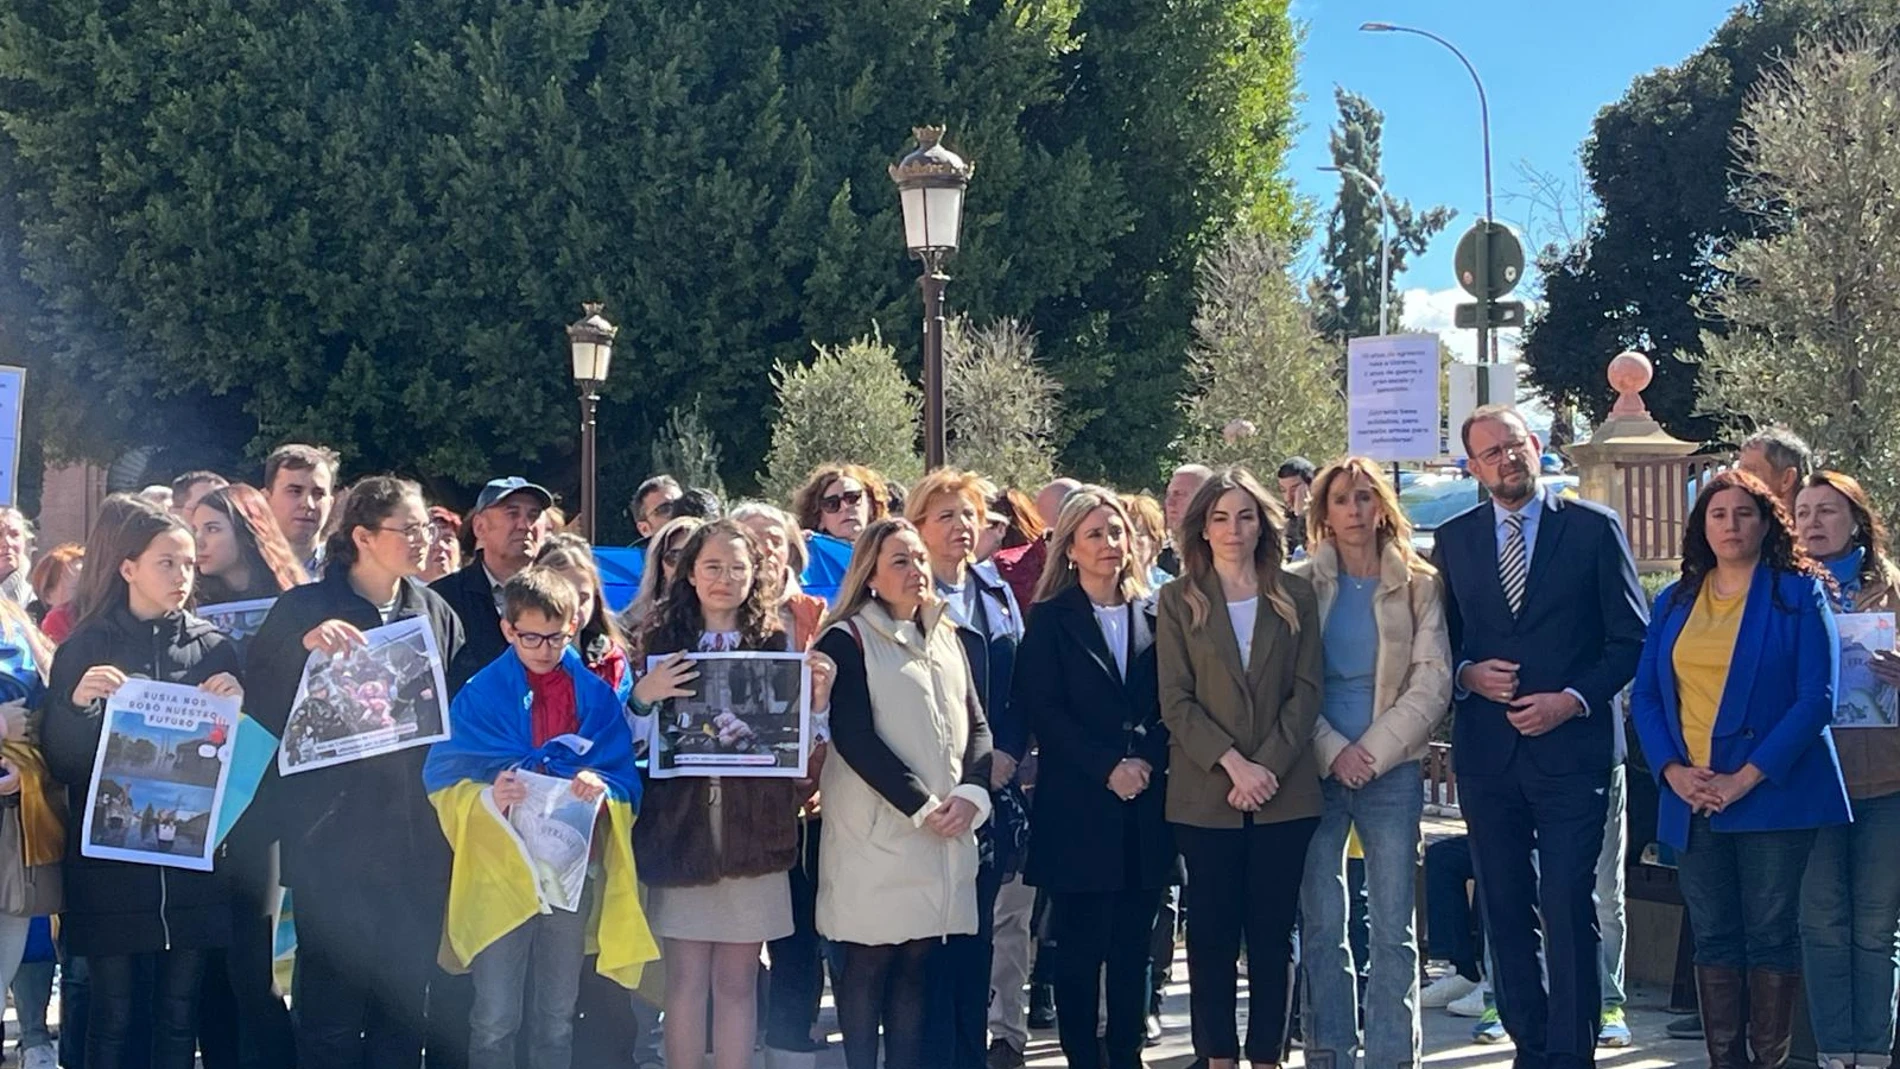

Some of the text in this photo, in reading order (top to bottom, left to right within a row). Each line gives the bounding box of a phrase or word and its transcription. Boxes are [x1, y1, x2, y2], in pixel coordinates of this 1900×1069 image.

[144, 691, 207, 707] RUSIA NOS
[165, 705, 218, 720] NUESTRO
[149, 714, 194, 727] FUTURO
